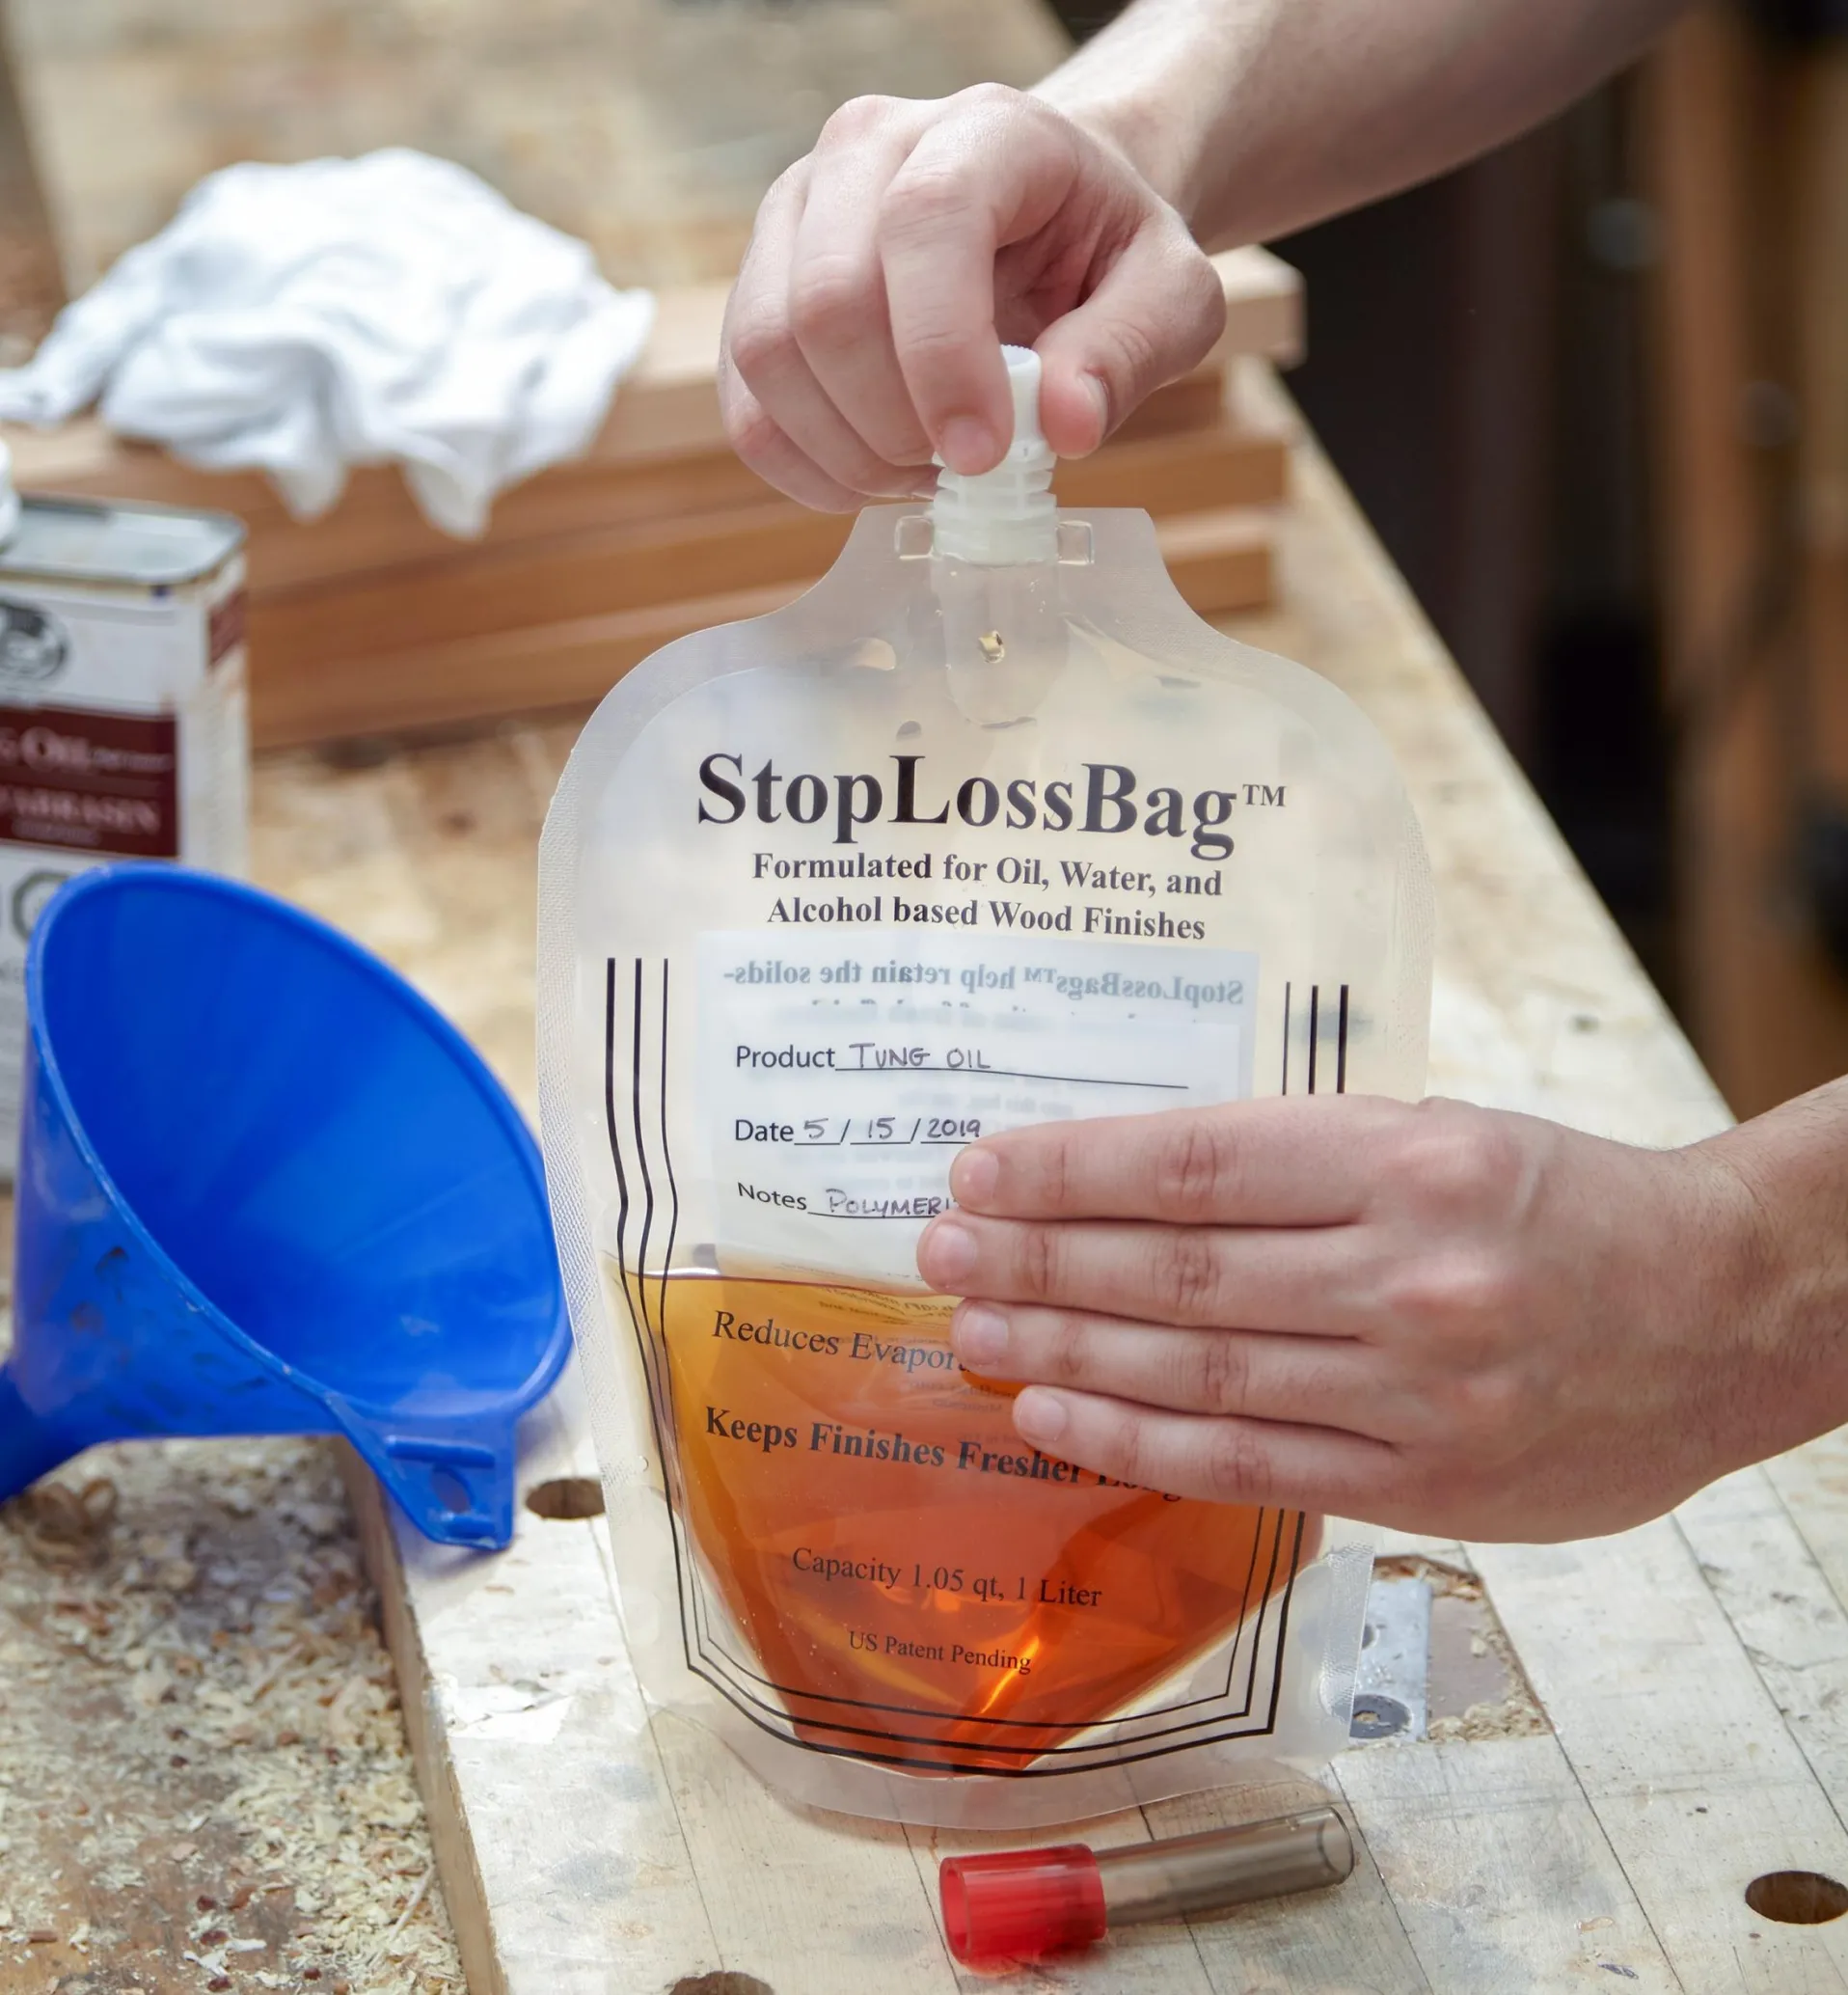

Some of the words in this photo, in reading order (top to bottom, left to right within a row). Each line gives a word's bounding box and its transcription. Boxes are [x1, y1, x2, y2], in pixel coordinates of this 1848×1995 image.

[752, 852, 932, 879] Formulated
[942, 854, 988, 882] for
[996, 857, 1049, 891] Oil,
[1060, 861, 1156, 898] Water,
[1166, 869, 1223, 896] and
[767, 896, 883, 923] Alcohol
[893, 896, 978, 926] based
[989, 899, 1073, 932] Wood
[1082, 906, 1206, 940] Finishes
[736, 1044, 835, 1068] Product
[848, 1043, 931, 1069] TUNG
[946, 1048, 992, 1069] OIL
[735, 1118, 795, 1142] Date
[737, 1181, 807, 1211] Notes
[712, 1309, 840, 1356] Reduces
[705, 1406, 798, 1453] Keeps
[809, 1421, 945, 1468] Finishes
[958, 1440, 1088, 1484] Fresher
[792, 1546, 902, 1590] Capacity
[911, 1564, 965, 1592] 1.05
[972, 1577, 1005, 1602] qt,
[1017, 1576, 1026, 1600] 1
[1038, 1578, 1102, 1607] Liter
[849, 1630, 879, 1653] US
[885, 1635, 944, 1661] Patent
[951, 1644, 1032, 1676] Pending
